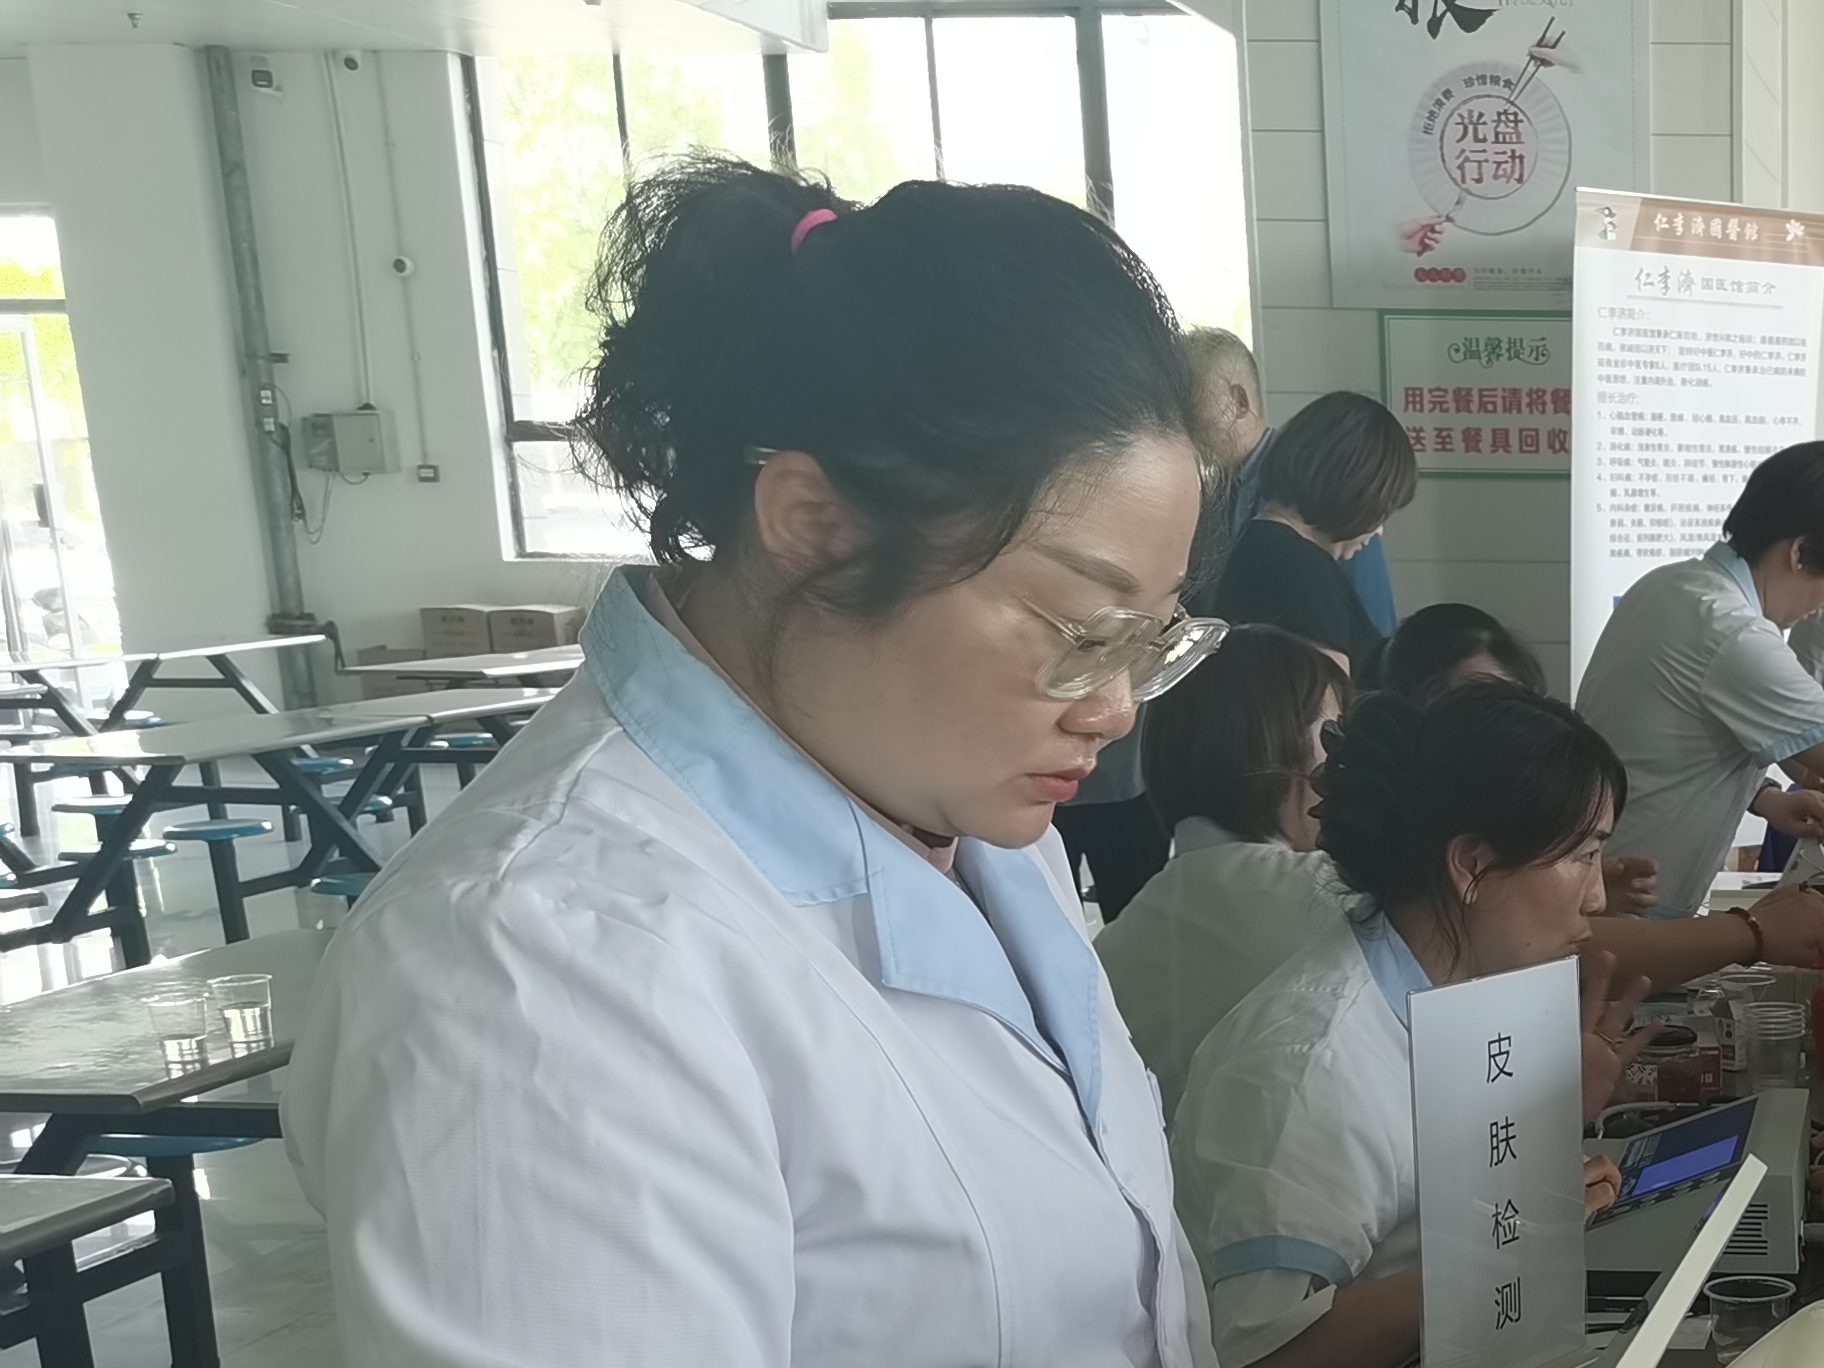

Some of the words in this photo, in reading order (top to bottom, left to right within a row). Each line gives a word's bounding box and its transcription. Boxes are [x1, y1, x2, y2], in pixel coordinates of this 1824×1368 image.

[1454, 109, 1525, 144] 光盘
[1455, 149, 1526, 185] 行动
[1455, 337, 1549, 364] 温馨提示
[1404, 387, 1571, 415] 用完餐后请将餐
[1406, 426, 1569, 454] 送至餐具回收
[1485, 1032, 1522, 1331] 皮肤检测
